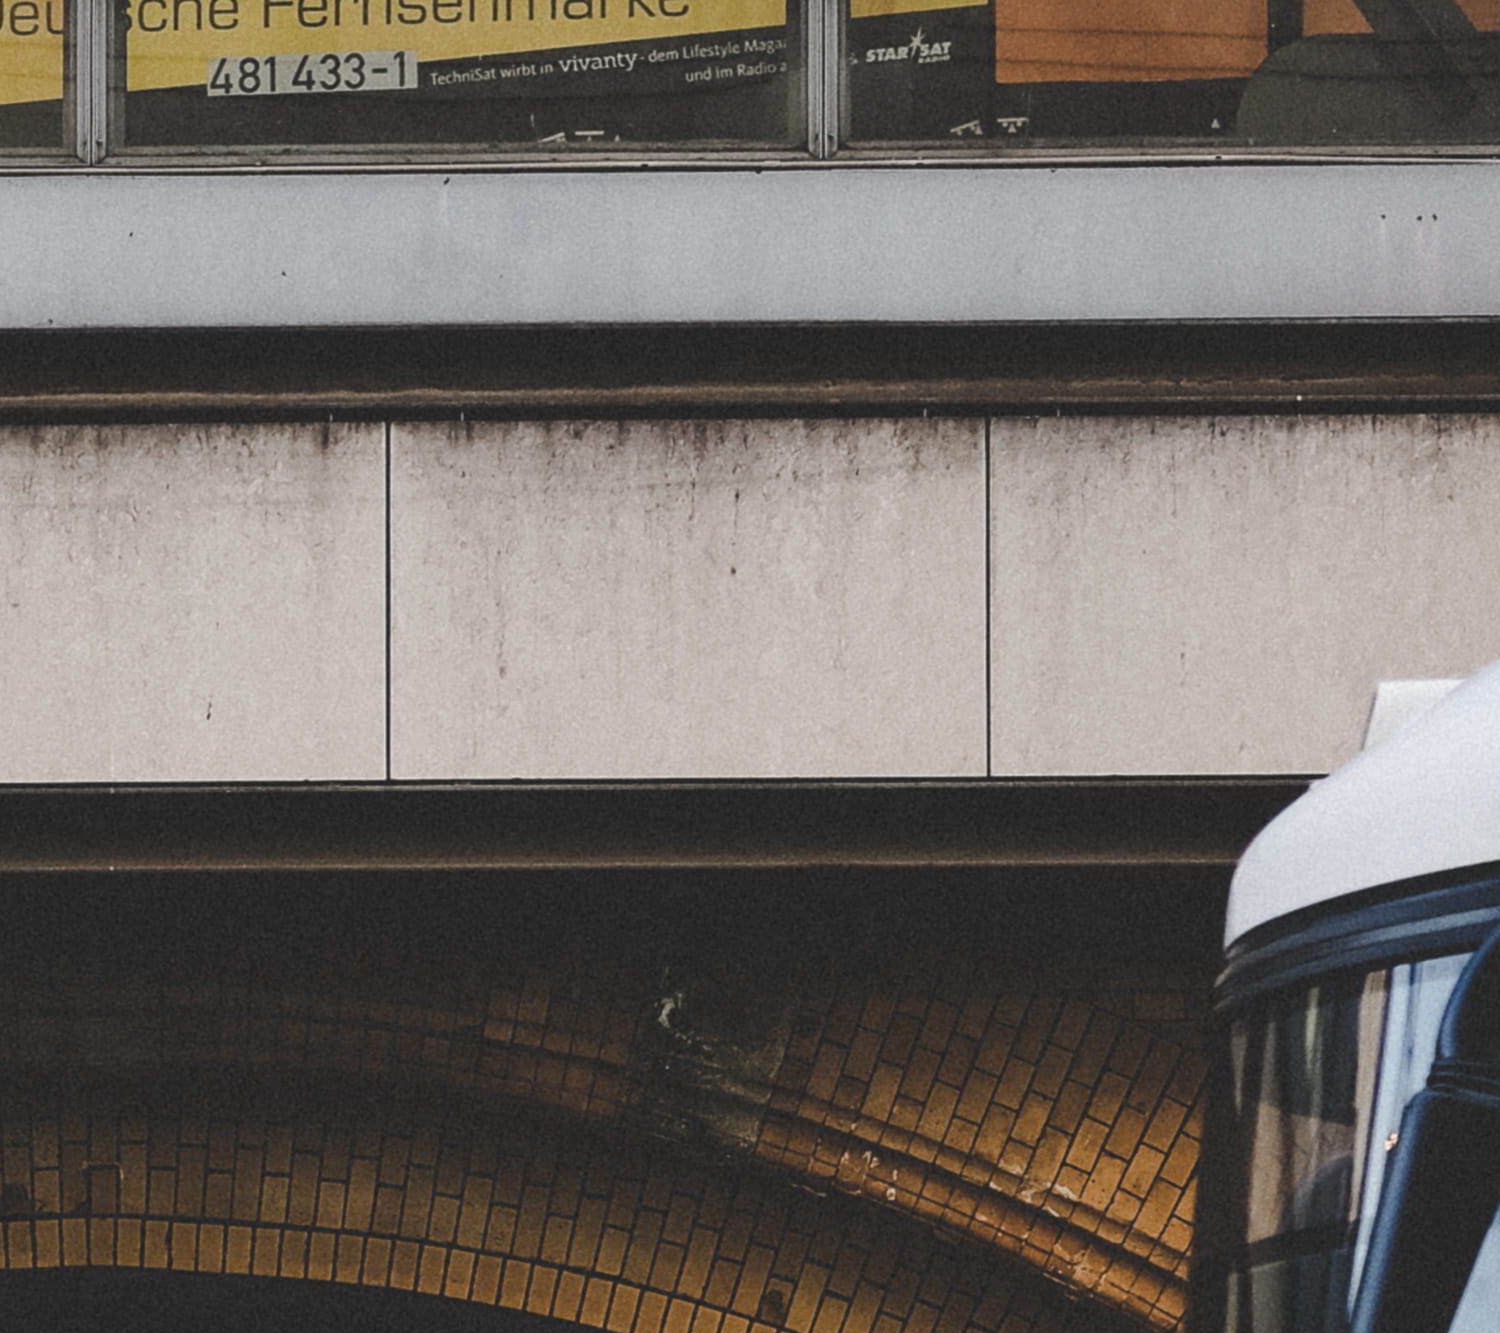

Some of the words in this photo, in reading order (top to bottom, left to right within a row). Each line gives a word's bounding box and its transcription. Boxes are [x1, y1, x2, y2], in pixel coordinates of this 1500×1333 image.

[430, 67, 497, 86] TechniSat
[500, 63, 537, 79] wirbt
[540, 61, 554, 74] in
[558, 52, 639, 72] vivanty
[647, 48, 680, 63] dem
[682, 40, 741, 59] Lifestyle
[865, 46, 909, 62] STAR
[919, 41, 953, 56] SAT
[209, 57, 276, 94] 481
[291, 51, 406, 90] 433-1
[684, 66, 713, 82] und
[736, 61, 777, 77] Radio
